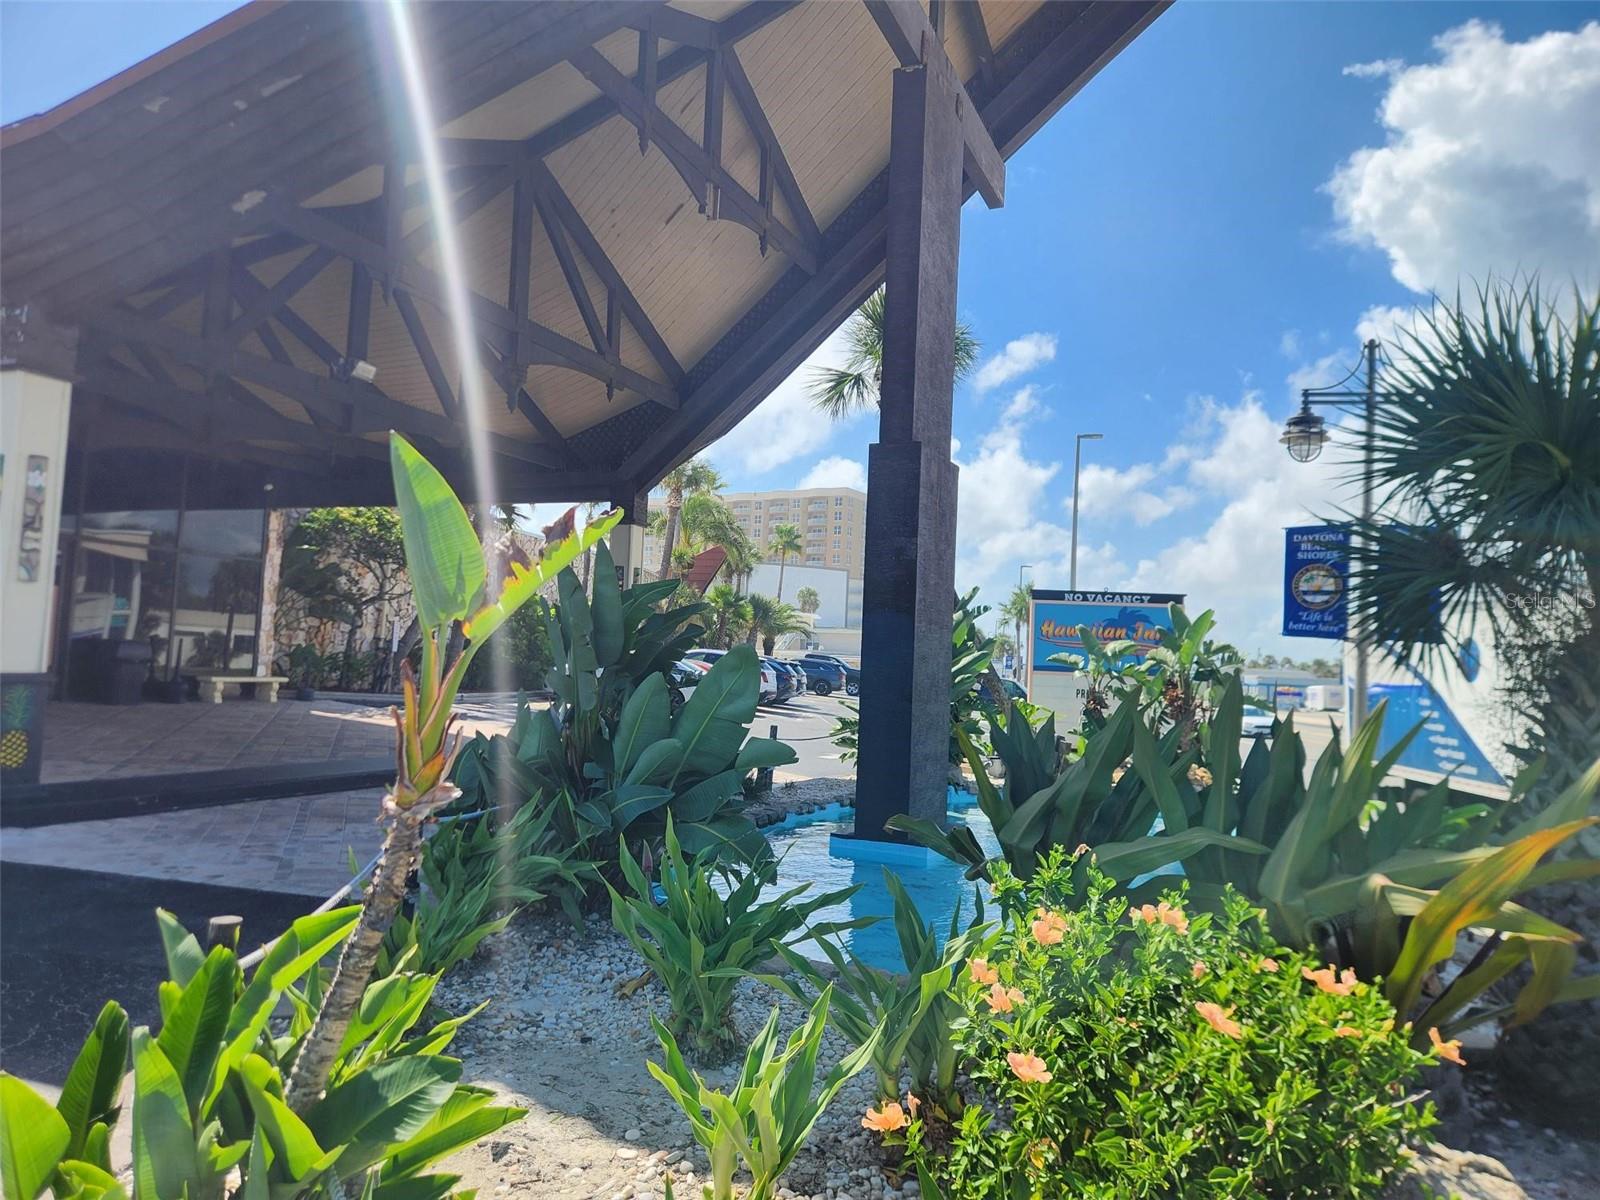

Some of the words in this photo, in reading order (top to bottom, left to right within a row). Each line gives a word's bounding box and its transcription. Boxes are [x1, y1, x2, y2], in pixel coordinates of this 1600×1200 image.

[1293, 533, 1344, 543] DAYTONA
[1064, 593, 1083, 602] NO
[1086, 593, 1151, 604] VACANCY
[1041, 618, 1128, 641] Hawiian
[1288, 621, 1317, 631] better
